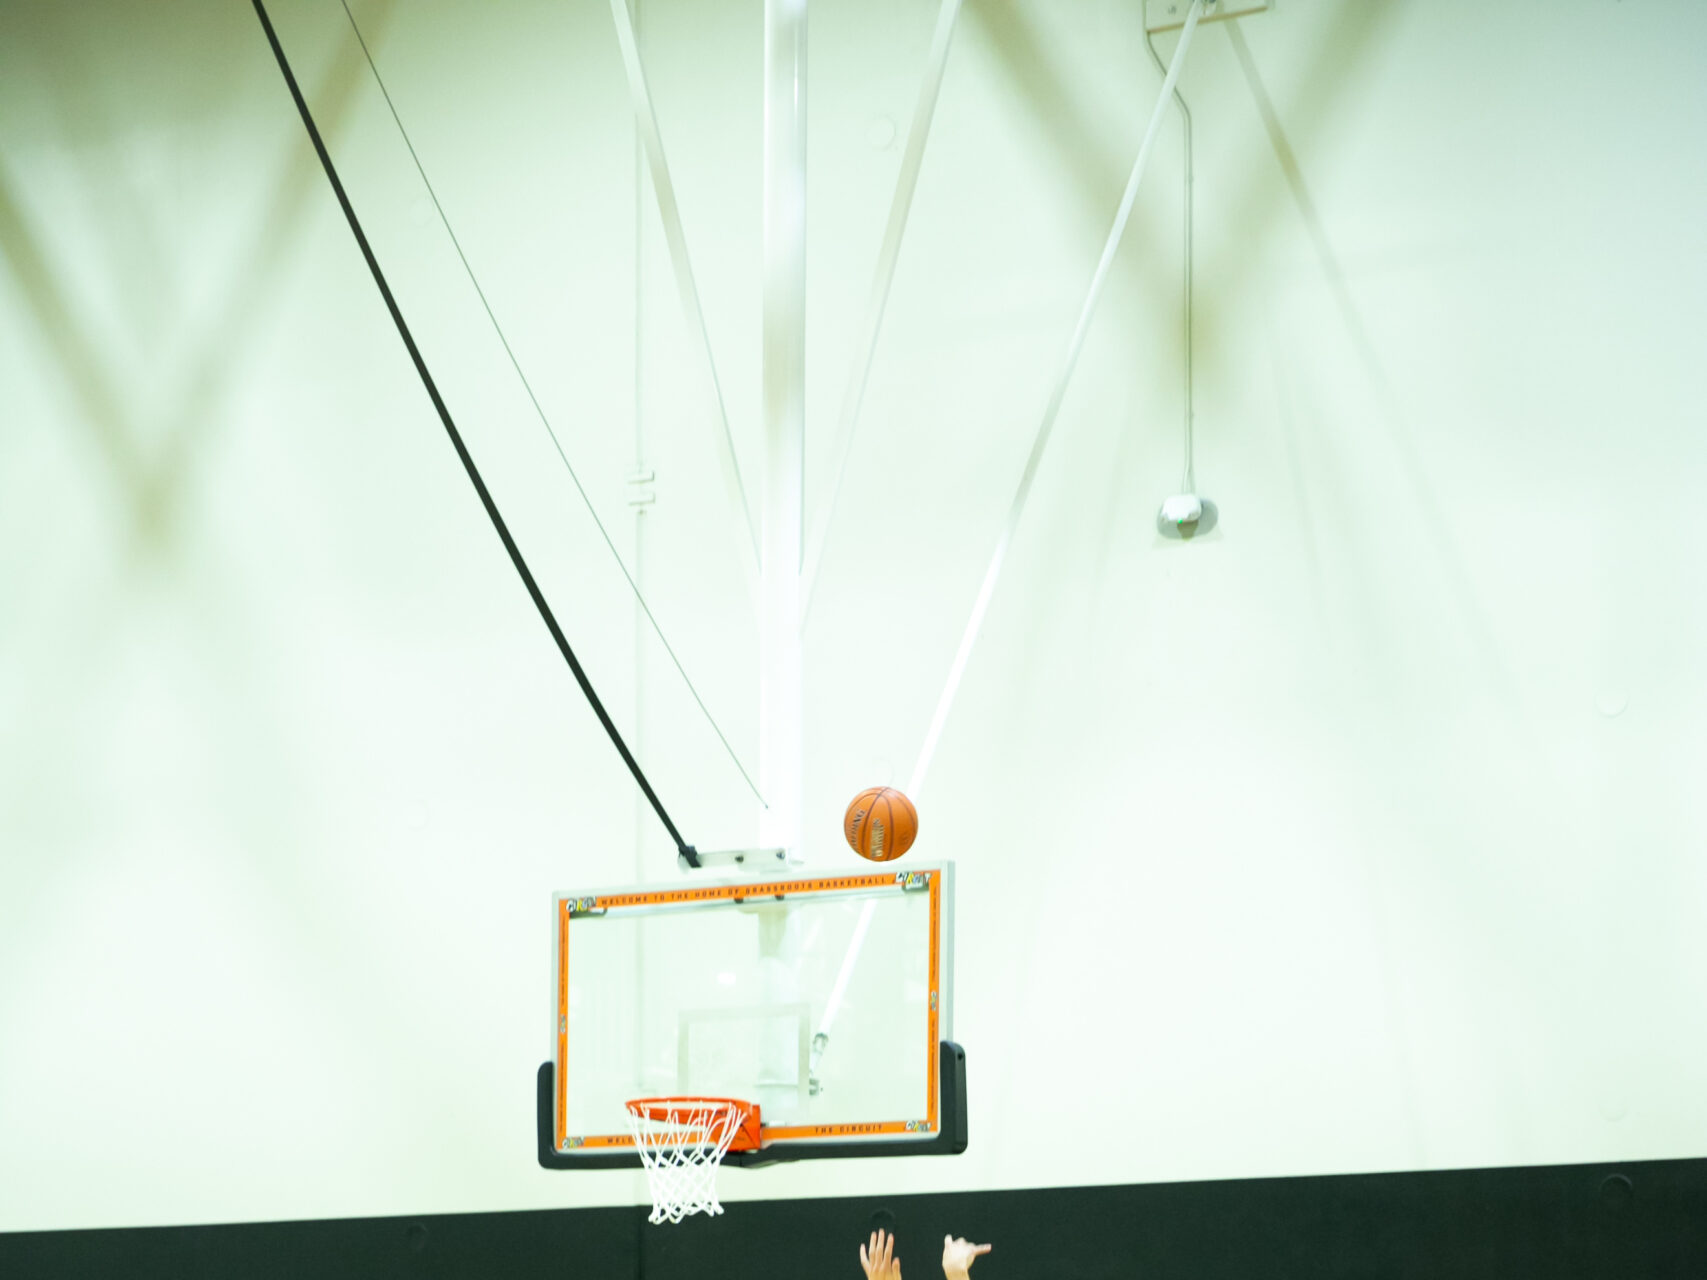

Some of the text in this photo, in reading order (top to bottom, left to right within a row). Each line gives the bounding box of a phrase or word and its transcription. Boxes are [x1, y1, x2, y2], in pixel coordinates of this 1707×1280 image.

[601, 896, 648, 906] WELCOME
[654, 894, 665, 902] TO
[671, 892, 689, 900] THE
[819, 876, 886, 889] BASKETBALL
[815, 1124, 883, 1134] THE CIRCUIT
